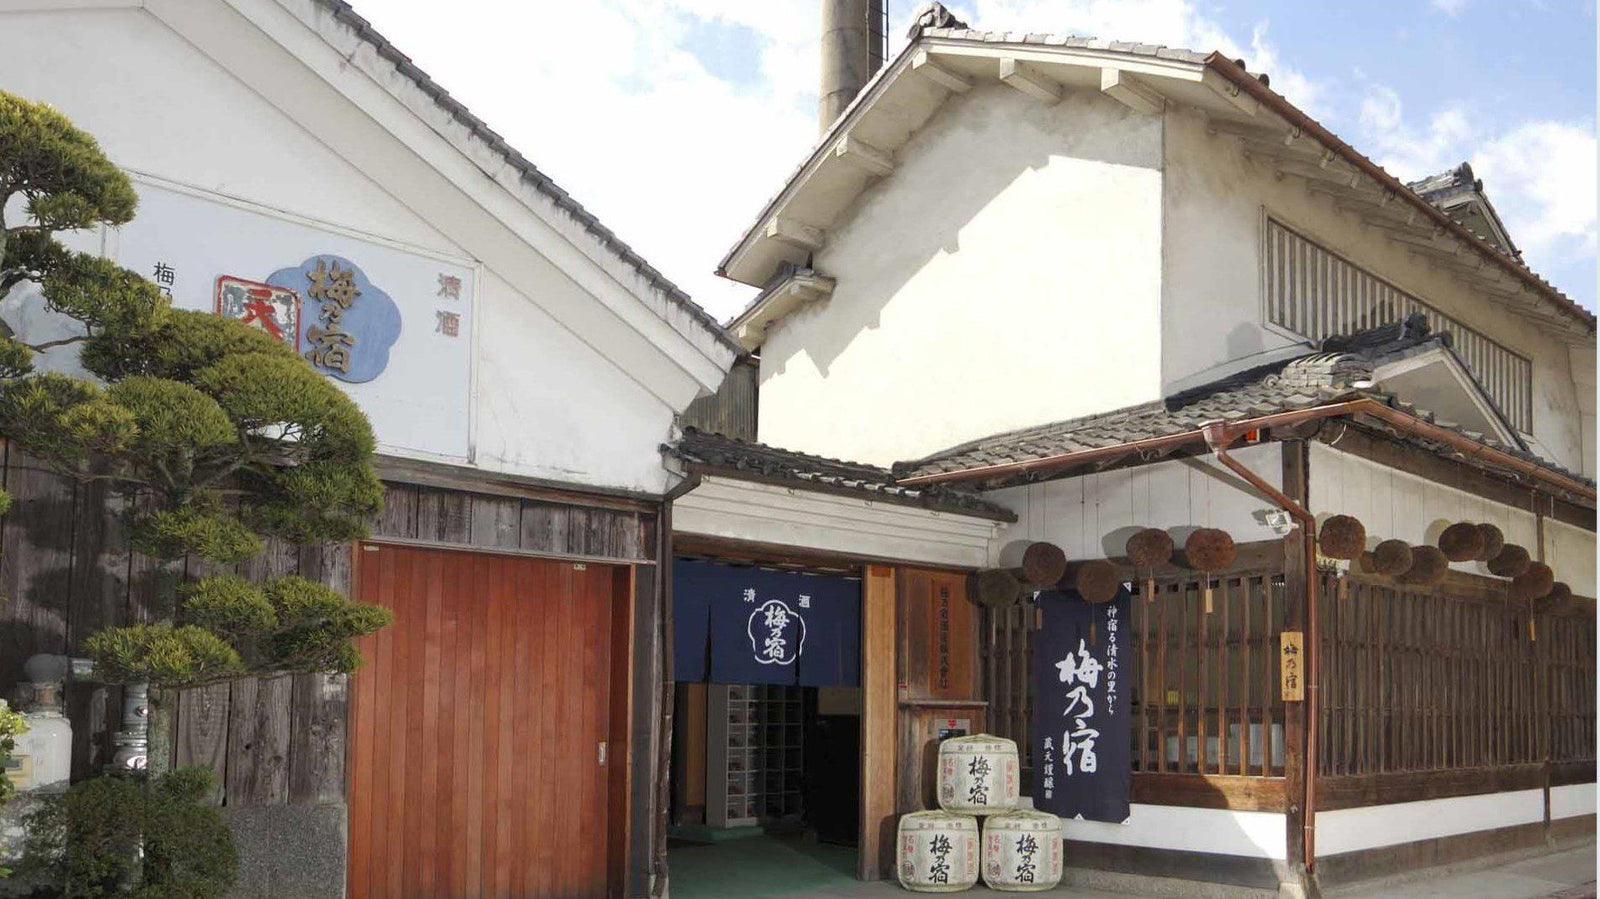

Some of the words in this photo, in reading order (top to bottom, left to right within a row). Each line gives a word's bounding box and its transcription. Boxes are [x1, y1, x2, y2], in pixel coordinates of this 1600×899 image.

[306, 257, 361, 373] 梅乃宿
[762, 604, 790, 659] 梅乃宿
[1283, 641, 1300, 690] 梅乃宿
[1055, 638, 1103, 776] 梅乃宿
[967, 754, 992, 806] 梅乃宿
[928, 833, 953, 885] 梅乃宿
[1015, 833, 1039, 884] 梅乃宿
